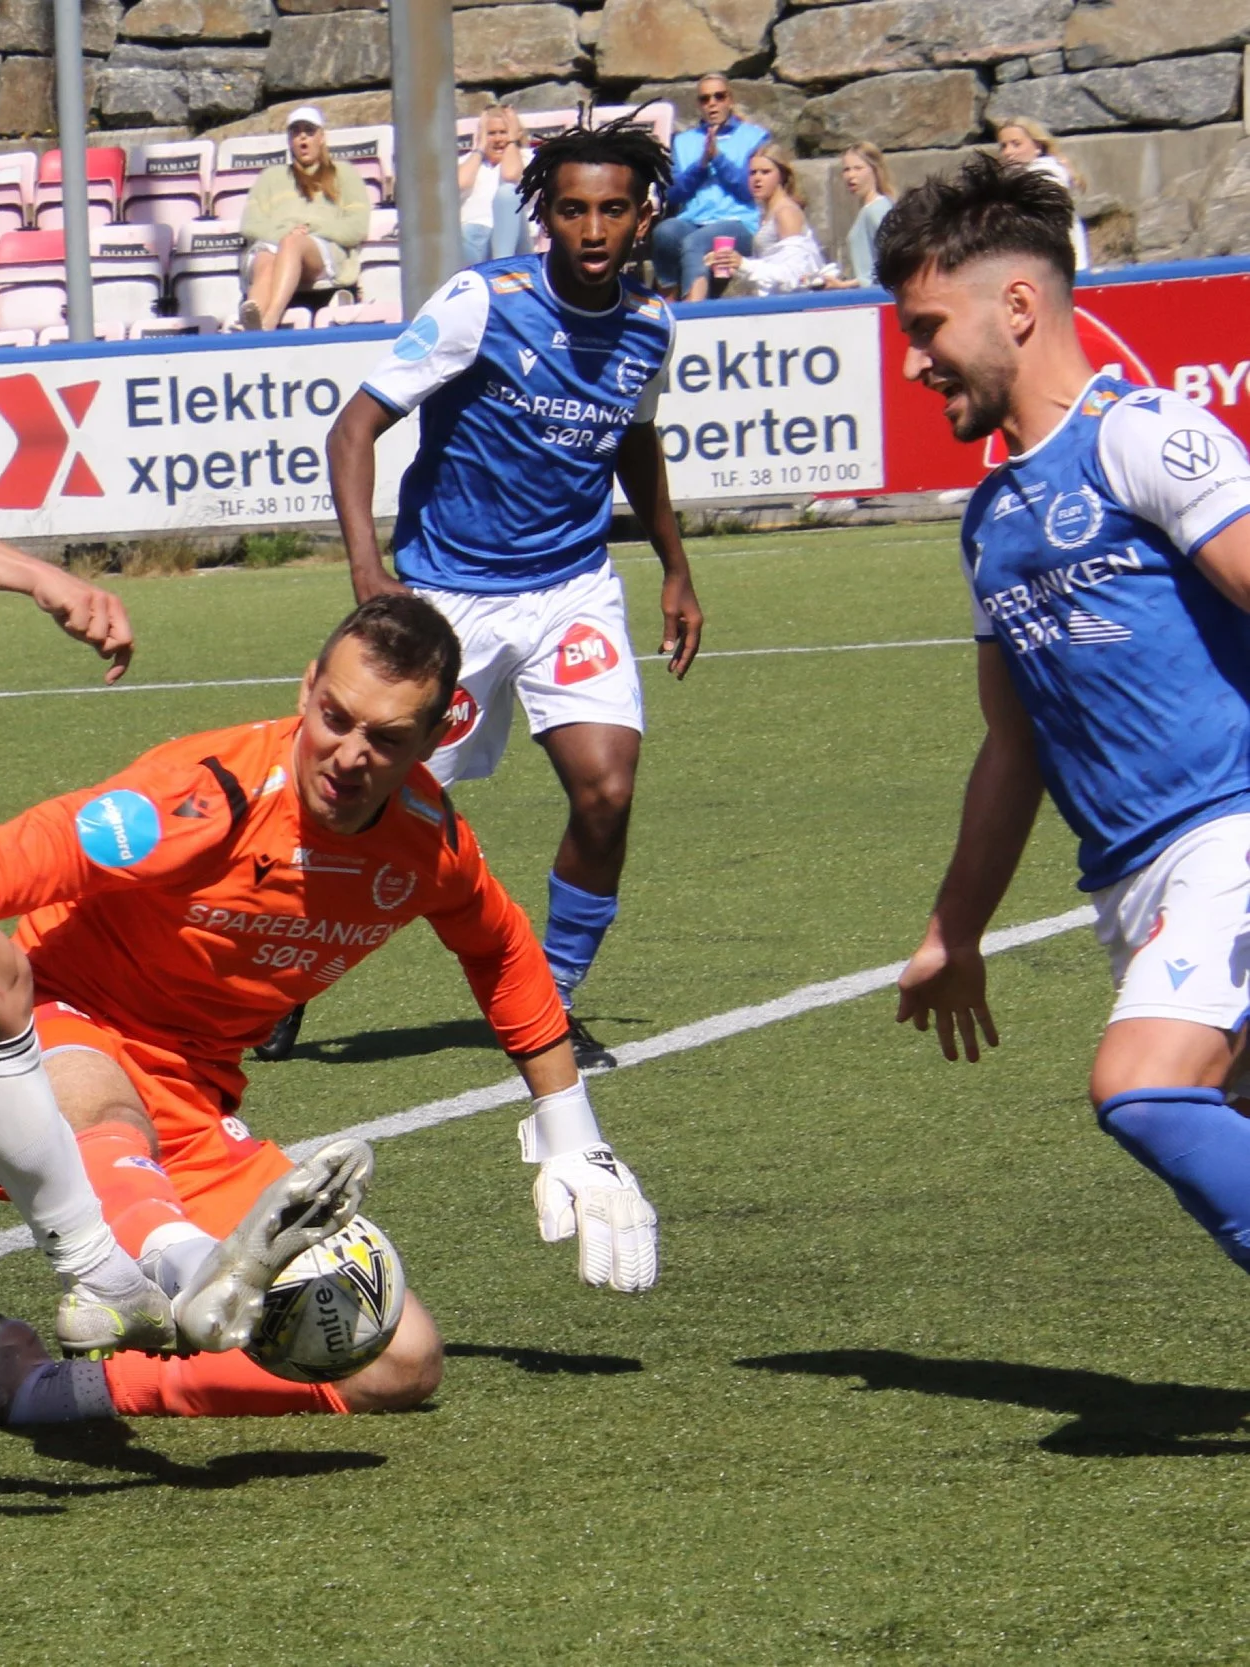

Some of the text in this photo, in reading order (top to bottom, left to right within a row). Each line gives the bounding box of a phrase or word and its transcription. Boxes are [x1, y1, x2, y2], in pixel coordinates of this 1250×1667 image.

[148, 160, 198, 172] DIAMANT
[193, 237, 245, 248] DIAMANT
[662, 340, 840, 393] ektro
[1173, 361, 1250, 407] BY
[126, 373, 341, 428] Elektro
[657, 408, 859, 463] perten
[127, 439, 332, 505] xperte
[712, 463, 860, 488] TLF. 38 10 70 00
[219, 494, 333, 517] TLF. 38 10 70
[565, 638, 607, 668] BM
[252, 943, 319, 972] SØR
[315, 1287, 345, 1354] mitre
